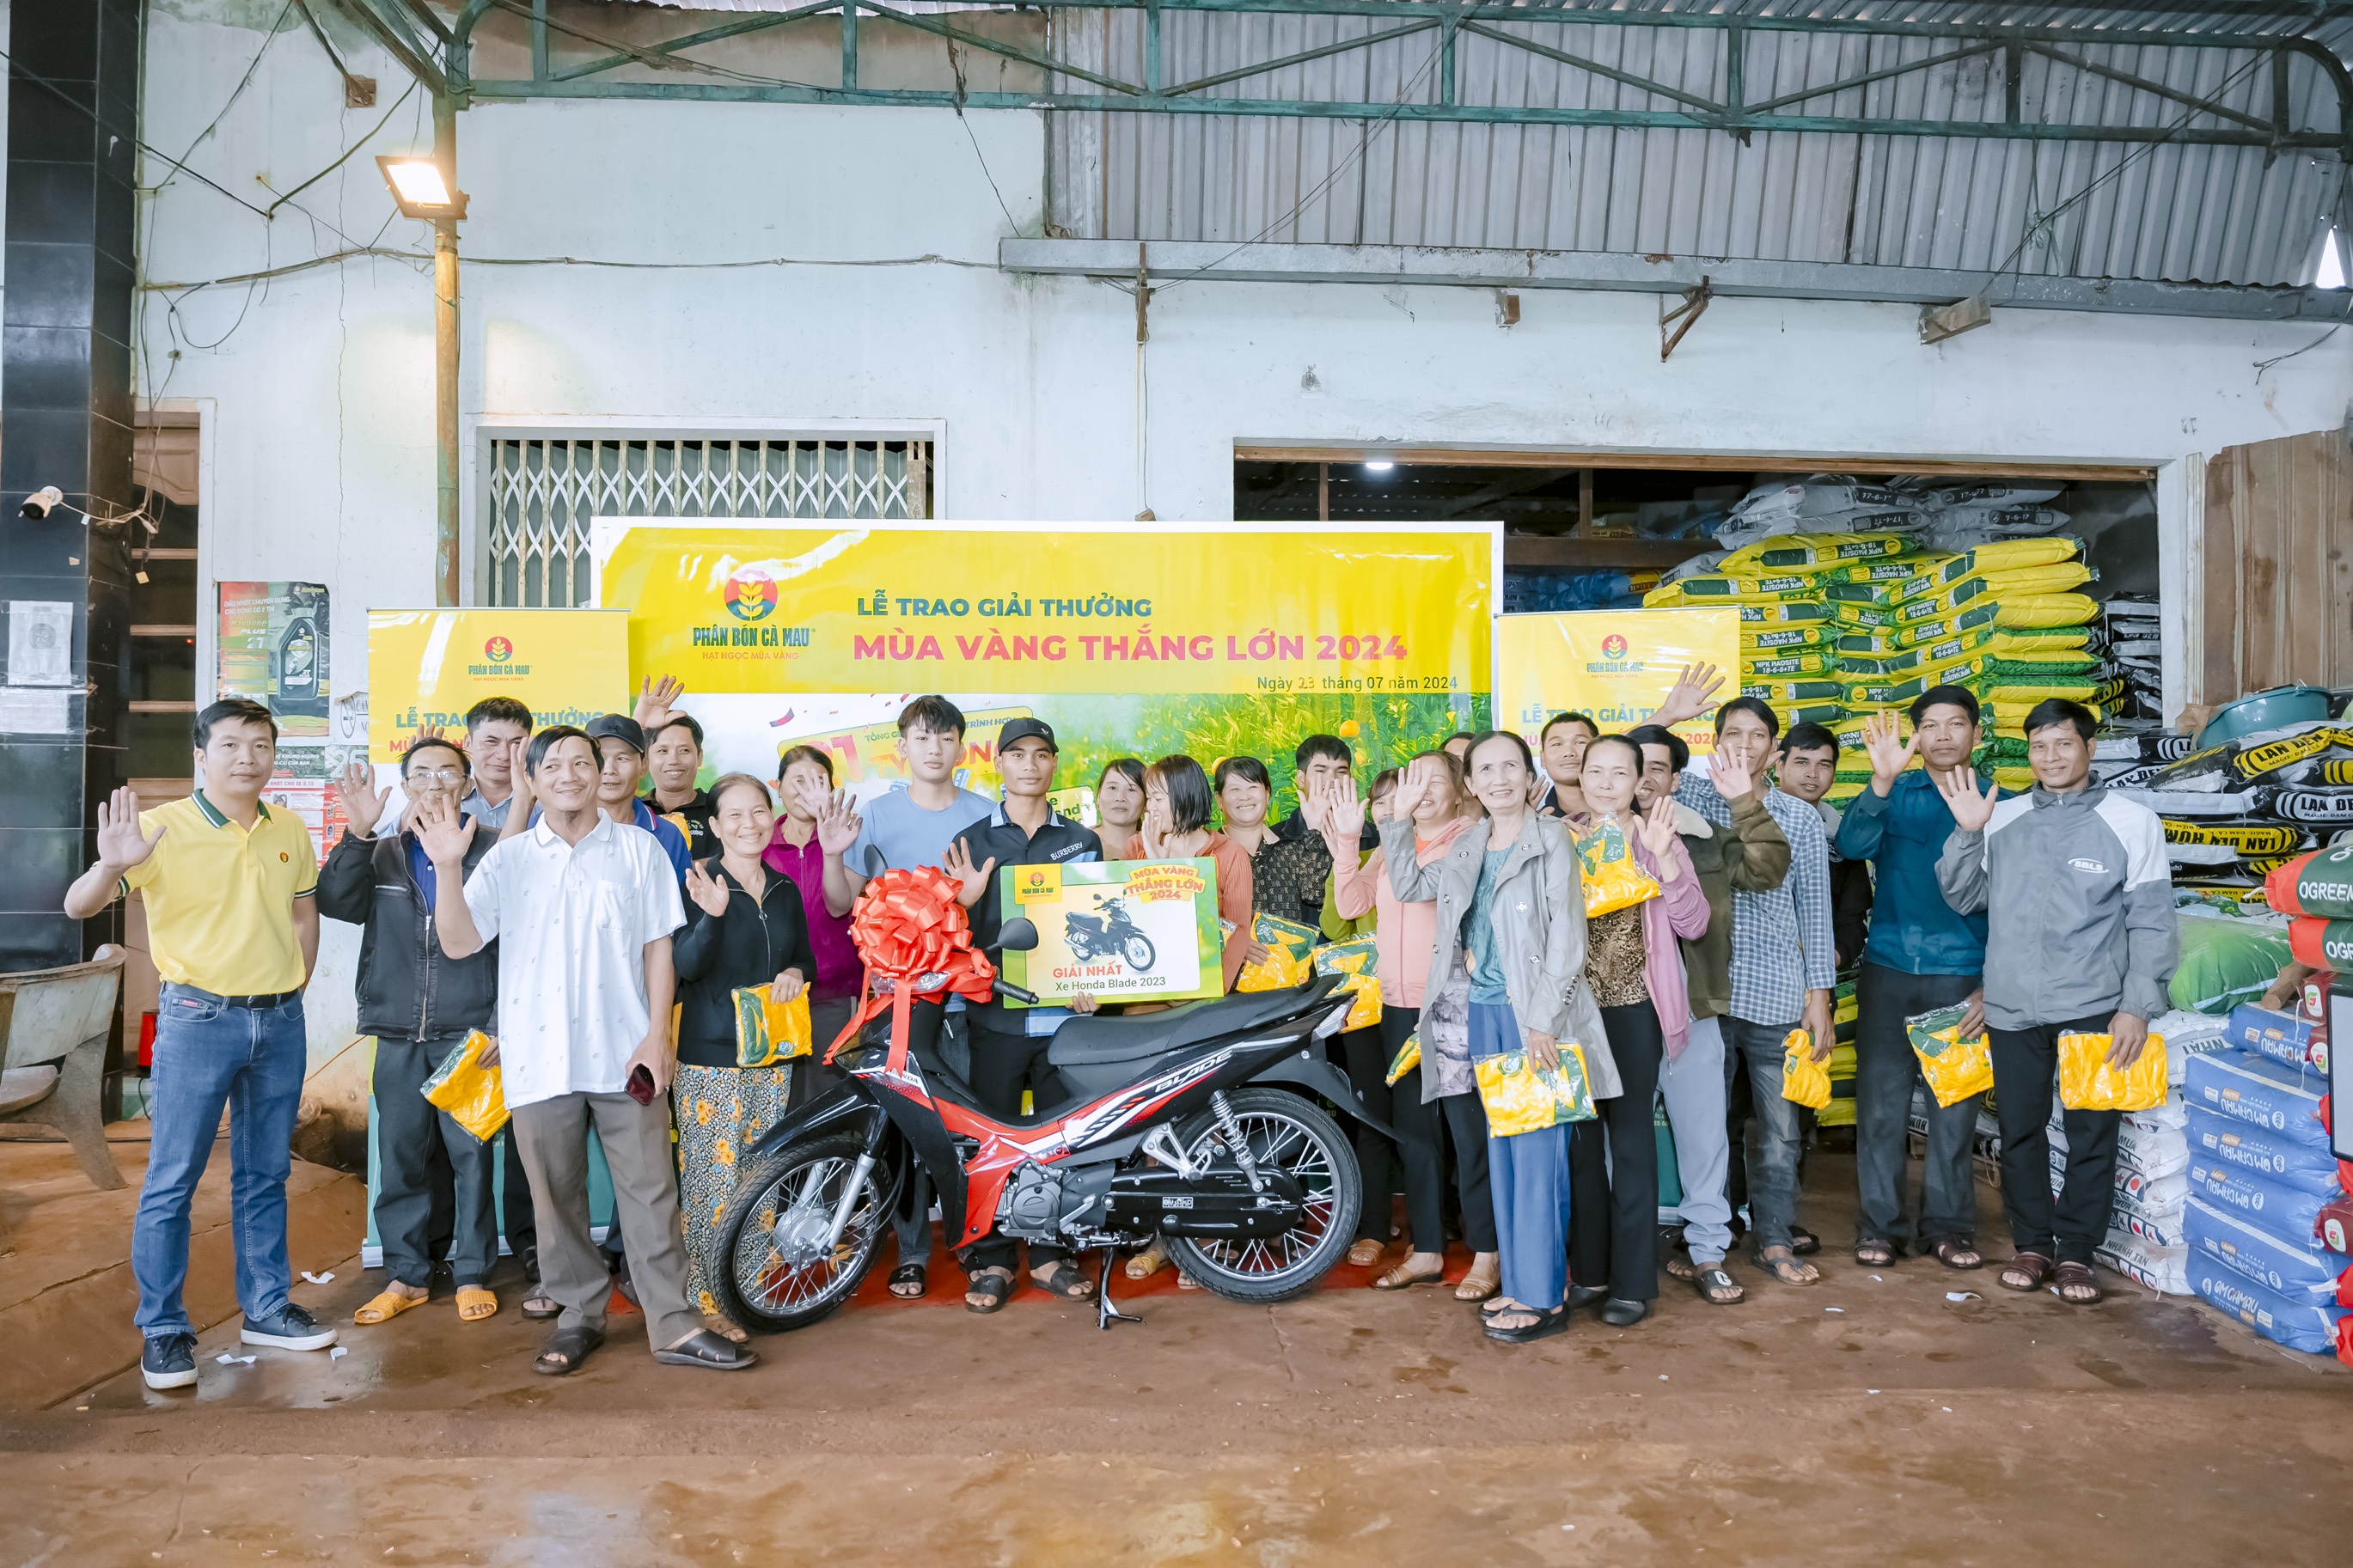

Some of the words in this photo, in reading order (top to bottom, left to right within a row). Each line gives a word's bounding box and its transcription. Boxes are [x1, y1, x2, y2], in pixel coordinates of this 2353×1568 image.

[858, 589, 888, 616] LỄ
[895, 598, 969, 617] TRAO
[977, 592, 1031, 617] GIẢI
[1040, 592, 1152, 617] THƯỞNG
[230, 619, 267, 627] Havoline
[1859, 616, 1879, 625] OSITE
[247, 637, 265, 649] 2T
[693, 625, 729, 646] PHÂN
[732, 625, 757, 646] BÓN
[761, 625, 777, 647] CÀ
[853, 627, 944, 661] MÙA
[955, 627, 1066, 661] VÀNG
[1079, 623, 1213, 661] THẮNG
[1227, 627, 1304, 661] LỚN
[1316, 635, 1408, 661] 2024
[1759, 638, 1788, 647] HAOSITE
[702, 652, 719, 662] HẠT
[721, 652, 749, 662] NGỌC
[751, 650, 771, 660] MÙA
[773, 650, 799, 660] VÀNG
[1771, 658, 1800, 667] HAOSITE
[468, 663, 487, 674] PHÂN
[489, 663, 503, 674] BÓN
[504, 663, 514, 674] CÀ
[1587, 662, 1604, 672] PHÂN
[1763, 665, 1795, 674] 18-6-6+TE
[1257, 676, 1293, 692] Ngày
[1322, 676, 1362, 692] tháng
[1366, 677, 1384, 689] 07
[1388, 676, 1418, 689] năm
[1422, 676, 1458, 689] 2024
[396, 706, 418, 728] LỄ
[1522, 703, 1542, 723] LỄ
[1598, 703, 1634, 723] GIẢI
[965, 719, 993, 729] TRÌNH
[865, 730, 889, 742] TỔNG
[1685, 733, 1712, 745] 202
[389, 736, 410, 752] MÙ
[2255, 744, 2290, 763] LAN
[330, 750, 369, 778] 25
[2301, 797, 2328, 812] LAN
[2165, 827, 2204, 845] HUM
[2246, 837, 2277, 850] LAN
[1050, 841, 1083, 861] BURBERRY
[1134, 868, 1159, 880] MÙA
[1162, 865, 1194, 876] VÀNG
[2074, 860, 2103, 871] SBLS
[1127, 878, 1175, 895] THẮNG
[1176, 878, 1203, 892] LỚN
[1150, 889, 1182, 900] 2024
[1053, 963, 1082, 979] GIẢI
[1085, 960, 1122, 977] NHẤT
[1055, 981, 1069, 991] Xe
[1072, 979, 1105, 991] Honda
[1108, 978, 1137, 988] Blade
[1140, 976, 1166, 986] 2023
[1155, 1049, 1232, 1093] BLADE
[2223, 1089, 2240, 1100] HAPPY
[2222, 1135, 2240, 1145] HAPPY
[2105, 1239, 2133, 1259] NHANH
[2134, 1253, 2149, 1267] TAN
